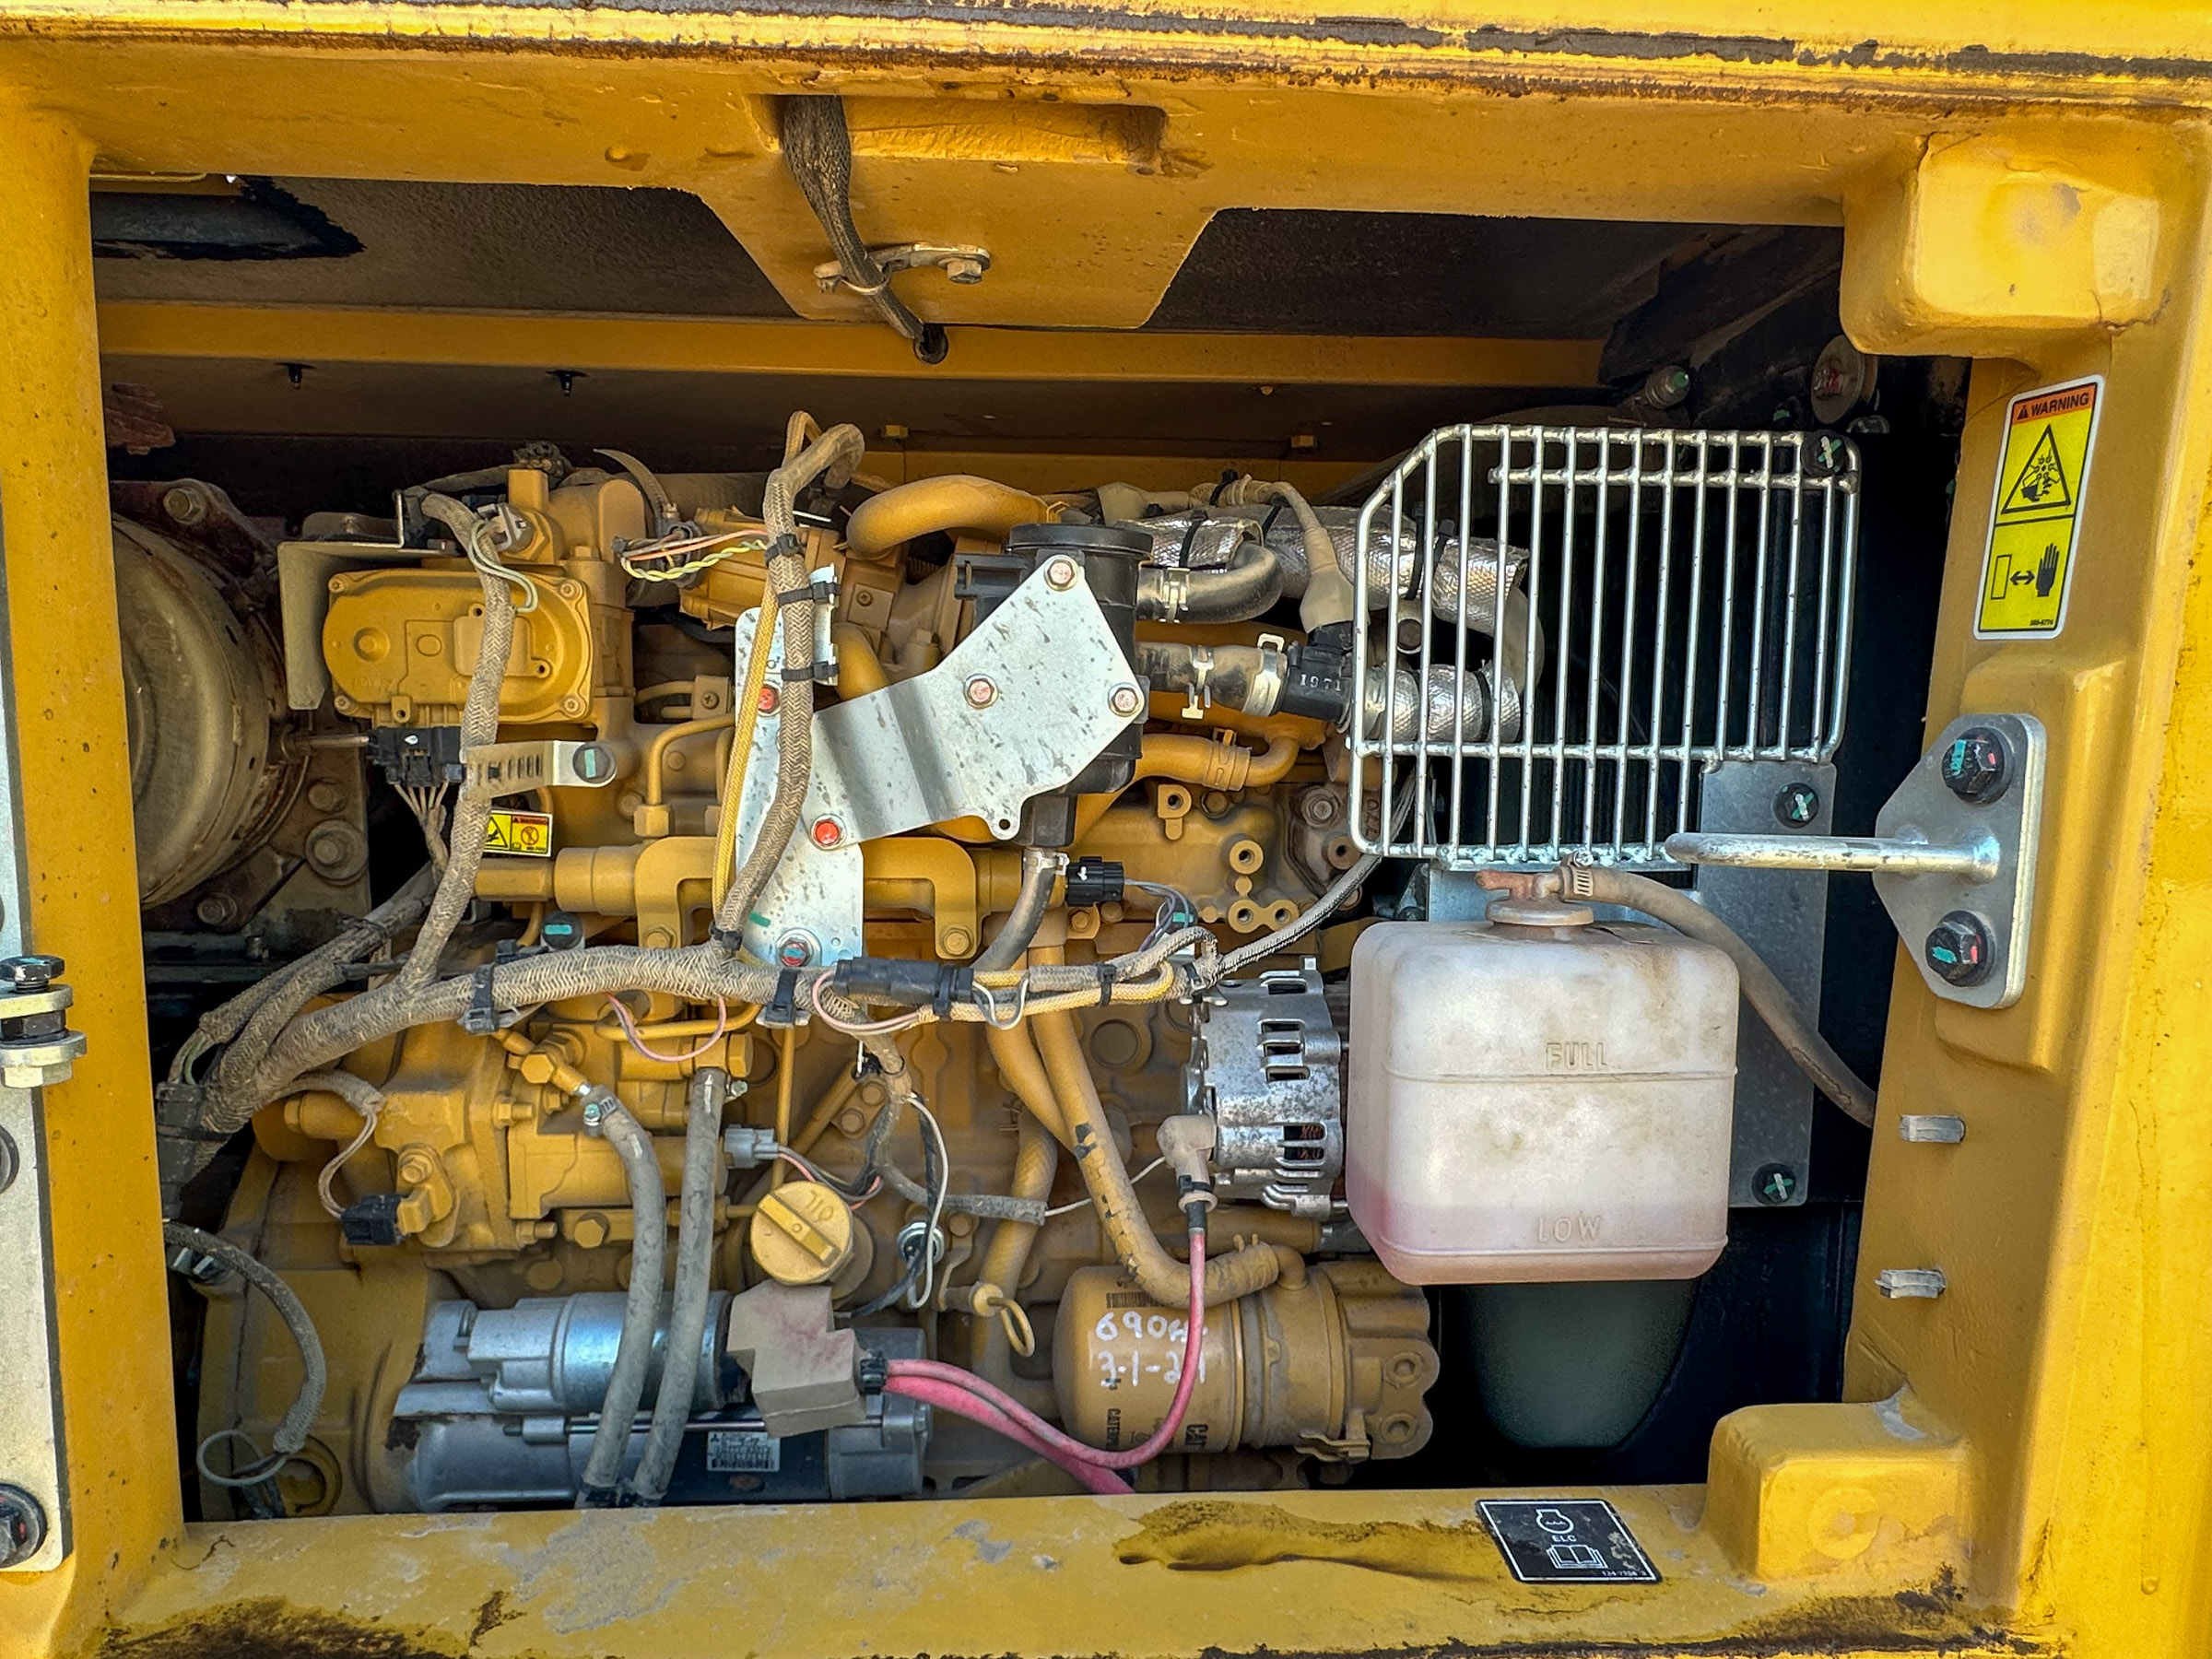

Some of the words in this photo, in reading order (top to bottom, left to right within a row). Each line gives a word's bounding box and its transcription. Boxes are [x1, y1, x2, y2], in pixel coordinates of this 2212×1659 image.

[2030, 393, 2089, 417] WARNING
[1300, 674, 1342, 692] 1971
[1546, 1041, 1608, 1071] FULL
[806, 1190, 834, 1221] OIL
[1537, 1216, 1601, 1243] LOW
[1185, 1424, 1208, 1450] CAT
[1551, 1535, 1577, 1543] ELC
